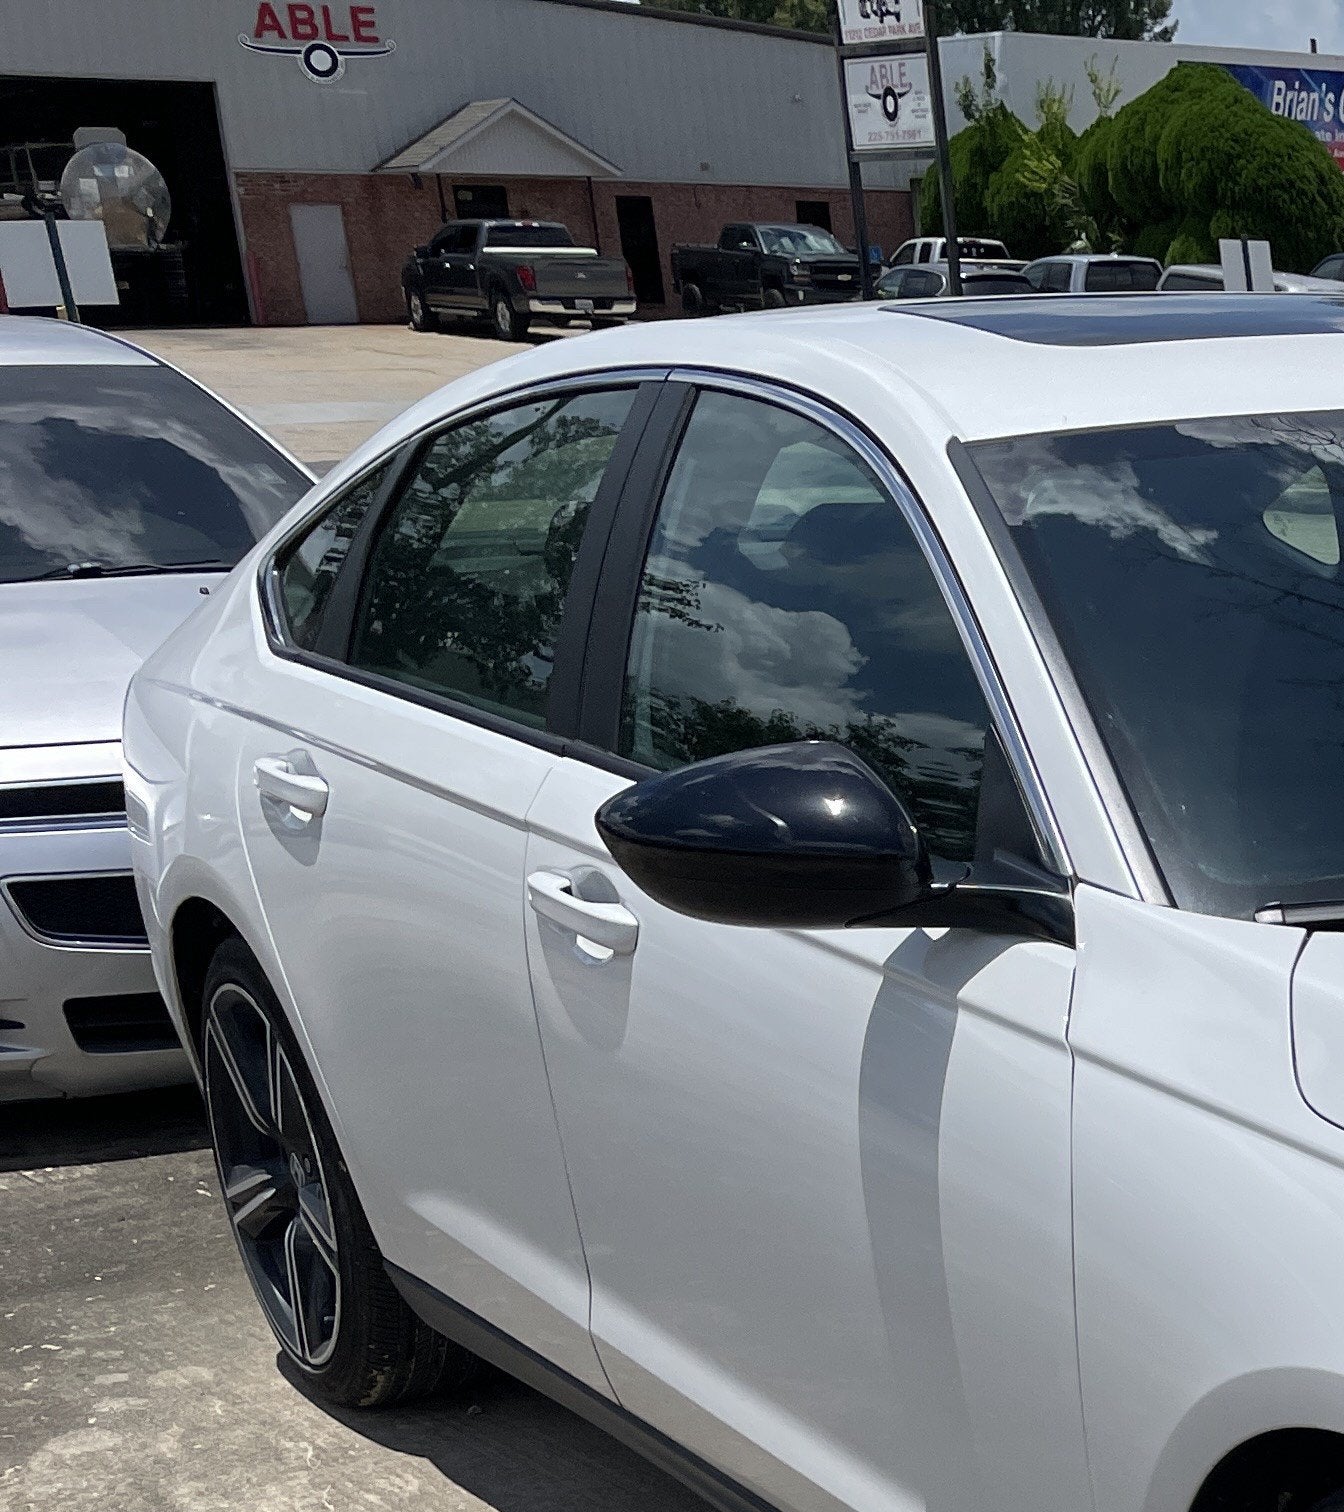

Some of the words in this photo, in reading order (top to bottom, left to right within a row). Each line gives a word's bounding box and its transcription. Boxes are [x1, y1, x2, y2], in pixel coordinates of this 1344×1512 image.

[254, 2, 380, 43] ABLE
[888, 24, 906, 36] PARK
[869, 62, 908, 90] ABLE
[1271, 80, 1335, 123] Brian's
